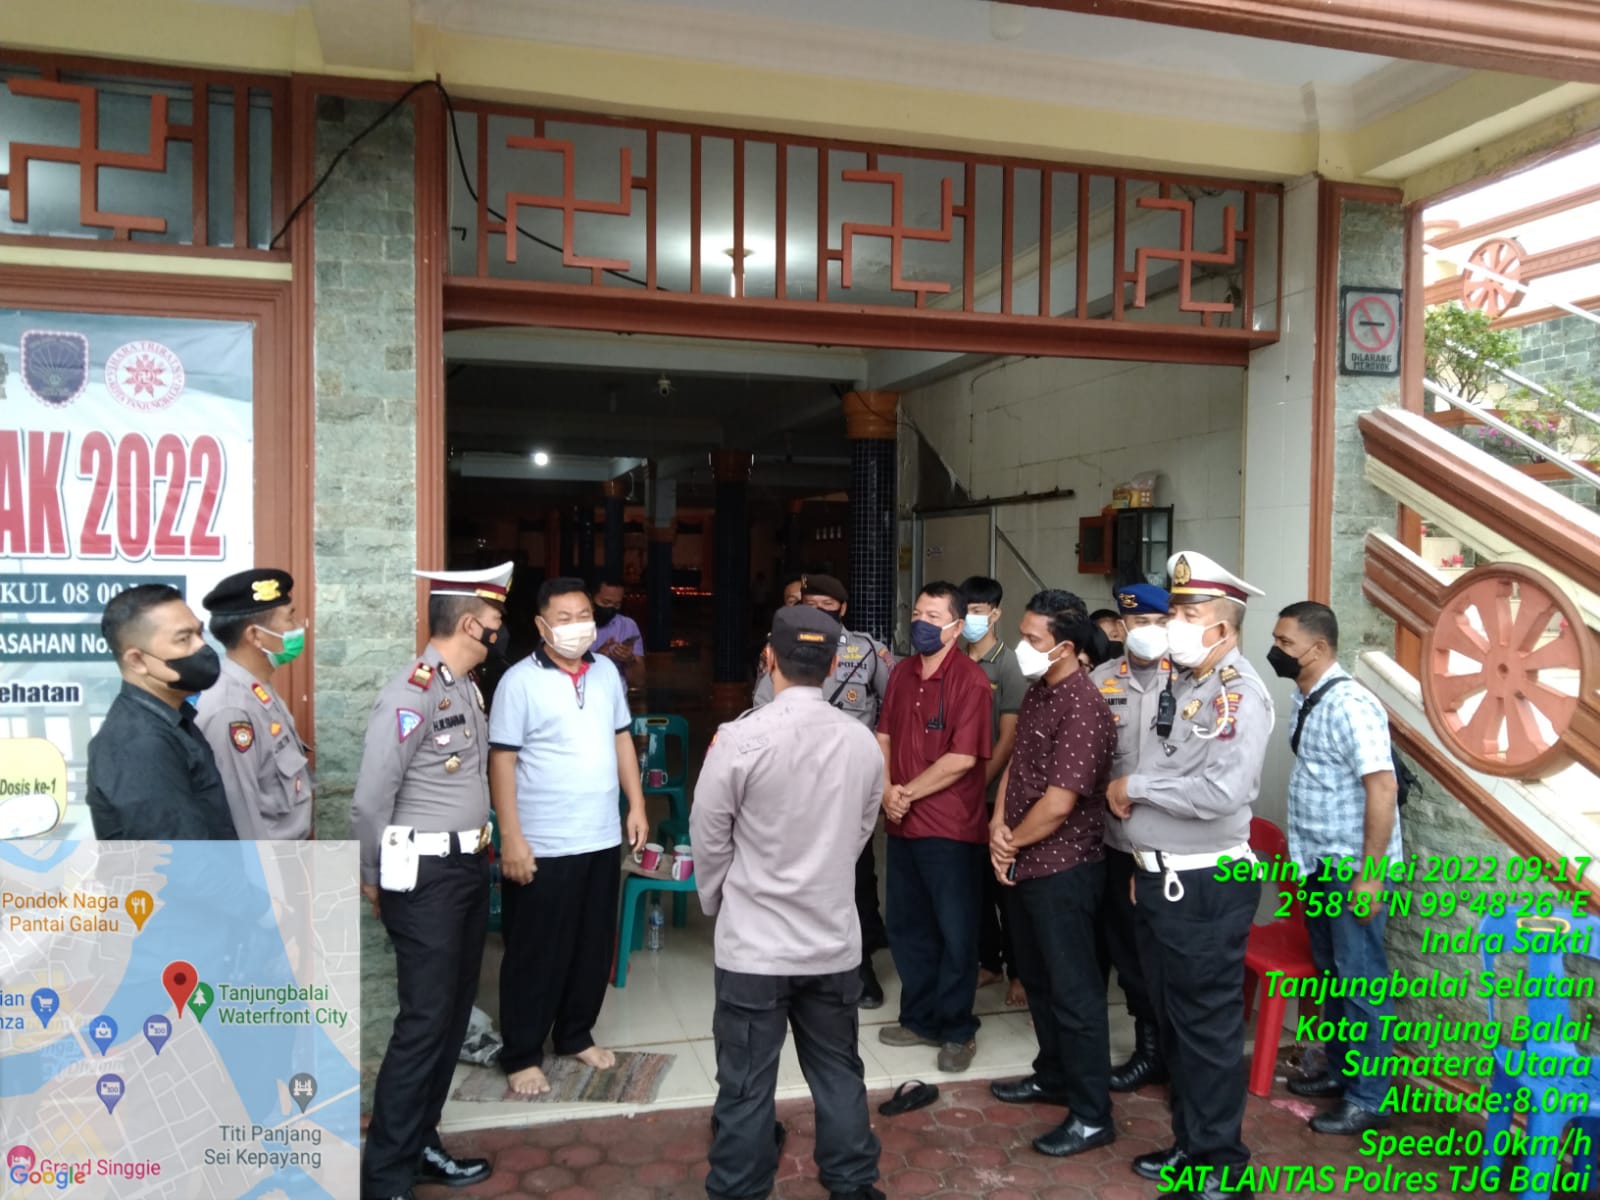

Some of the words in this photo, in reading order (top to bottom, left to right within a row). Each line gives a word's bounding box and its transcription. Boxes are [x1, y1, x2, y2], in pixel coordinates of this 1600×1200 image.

[79, 430, 222, 558] 2022
[1, 582, 56, 604] KUL
[62, 582, 90, 605] 08
[838, 661, 868, 670] POLI
[0, 683, 79, 703] ehatan
[0, 778, 30, 796] Dosis
[34, 777, 56, 795] ke-1
